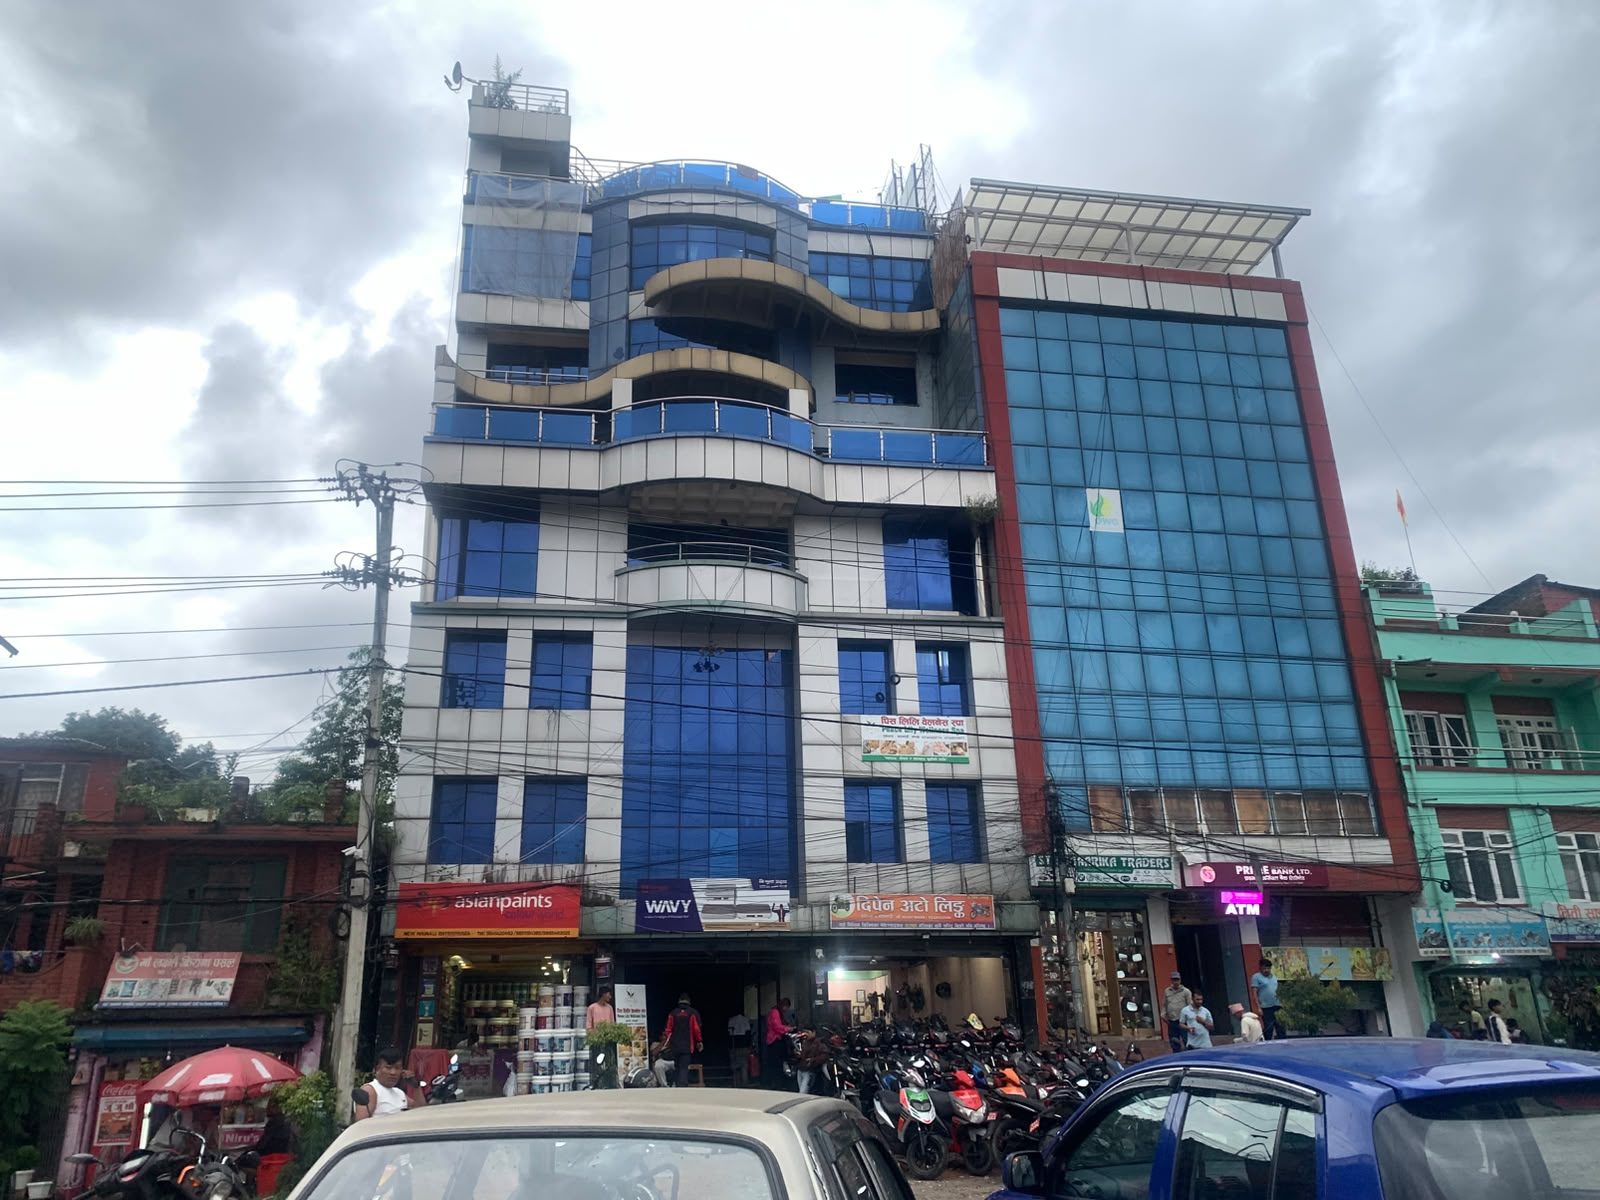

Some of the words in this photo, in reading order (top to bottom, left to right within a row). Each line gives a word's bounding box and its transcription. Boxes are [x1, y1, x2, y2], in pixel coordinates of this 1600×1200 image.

[1121, 857, 1170, 869] TRADERS
[1236, 865, 1270, 875] PRIE
[1296, 868, 1313, 876] LTD.
[455, 892, 553, 914] asianpaints
[645, 899, 692, 914] WAVY
[900, 898, 928, 912] अटो
[1225, 903, 1260, 916] ATM
